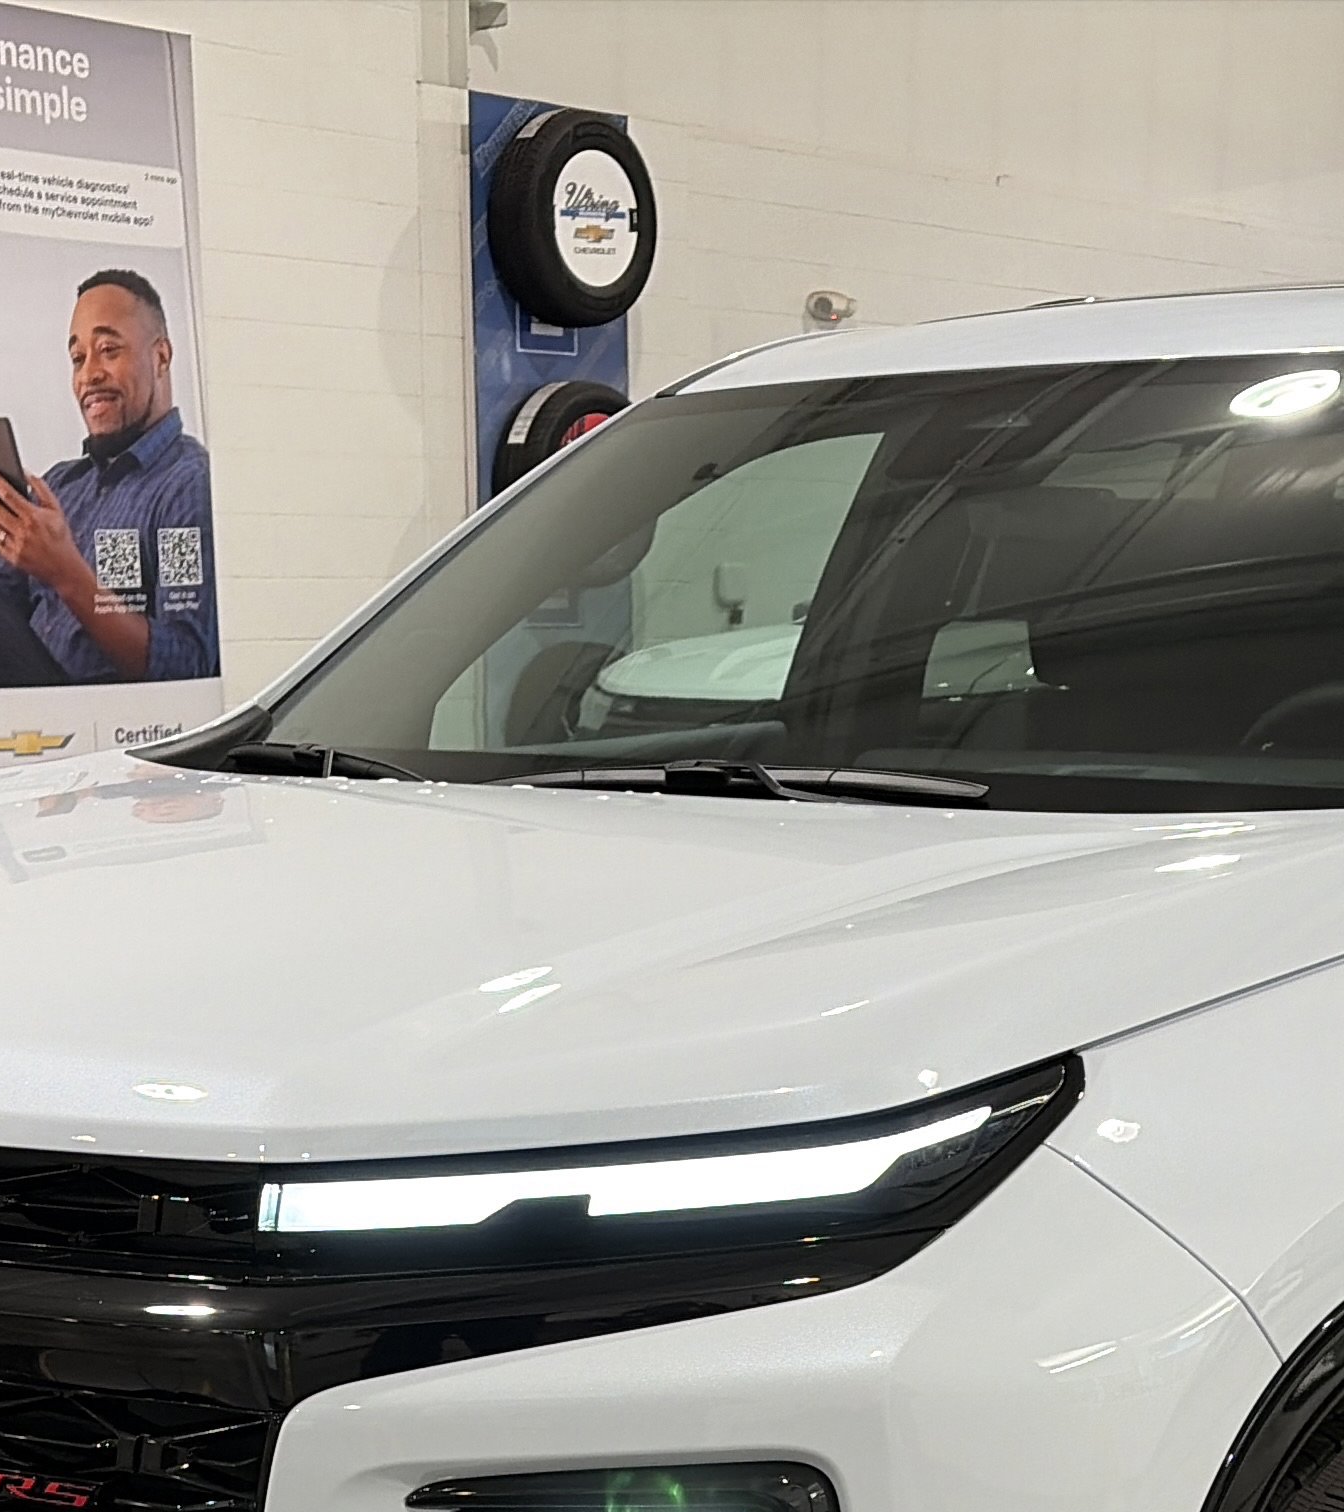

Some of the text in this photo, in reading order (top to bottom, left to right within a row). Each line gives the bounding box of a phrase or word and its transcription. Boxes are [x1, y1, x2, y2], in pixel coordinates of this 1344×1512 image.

[42, 174, 74, 189] vehicle
[45, 189, 78, 203] service
[80, 195, 137, 211] appointment
[23, 203, 39, 215] the
[101, 212, 131, 225] mobile
[115, 723, 182, 743] Certified
